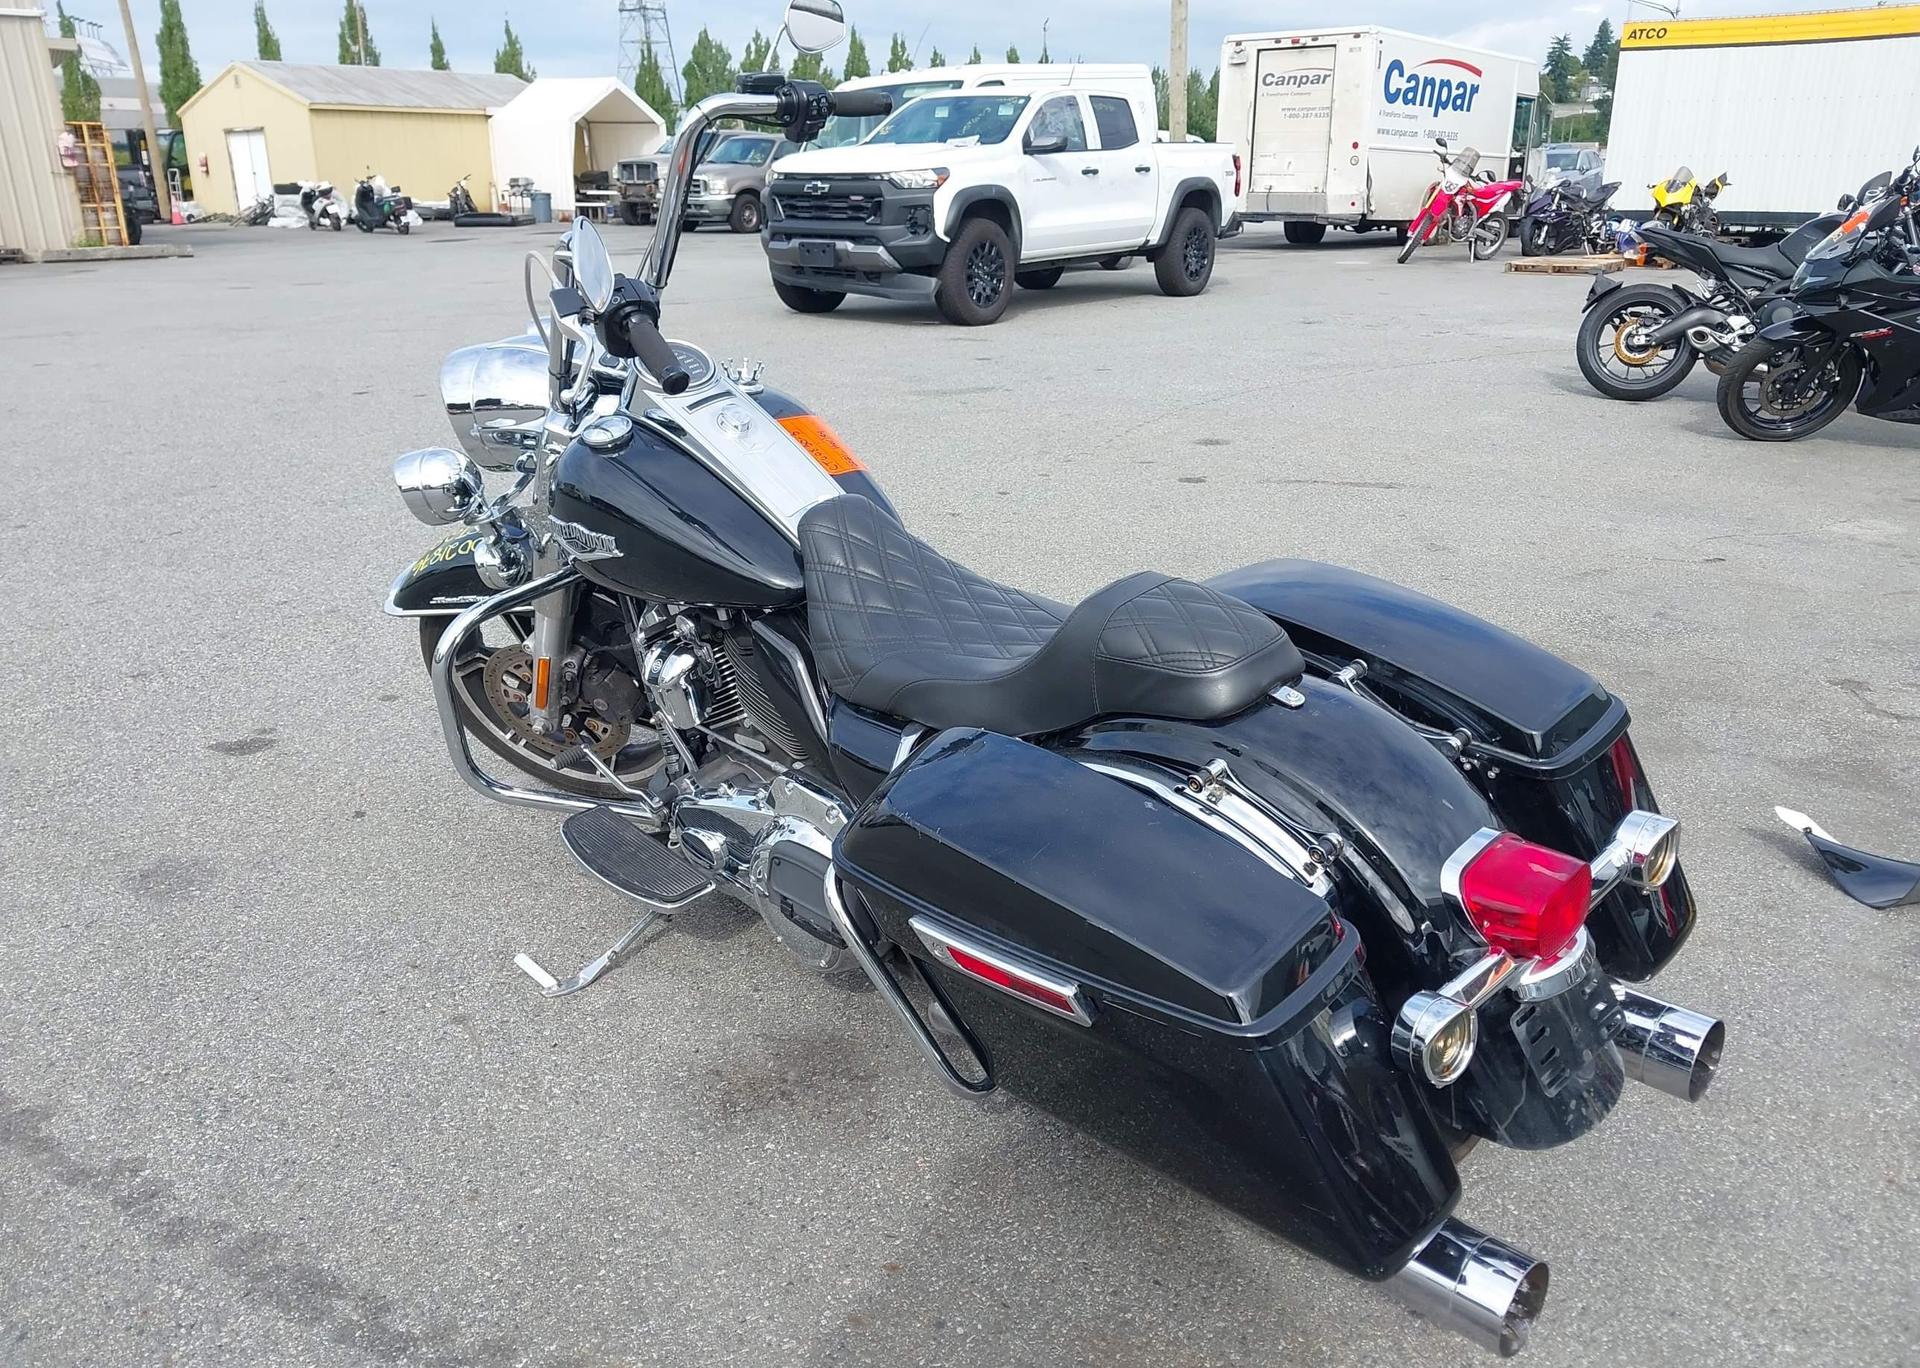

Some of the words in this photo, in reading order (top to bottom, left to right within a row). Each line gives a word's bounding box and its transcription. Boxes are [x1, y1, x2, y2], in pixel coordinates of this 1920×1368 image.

[1627, 27, 1668, 40] ATCO
[1262, 72, 1331, 88] Canpar
[1384, 59, 1480, 118] Canpar
